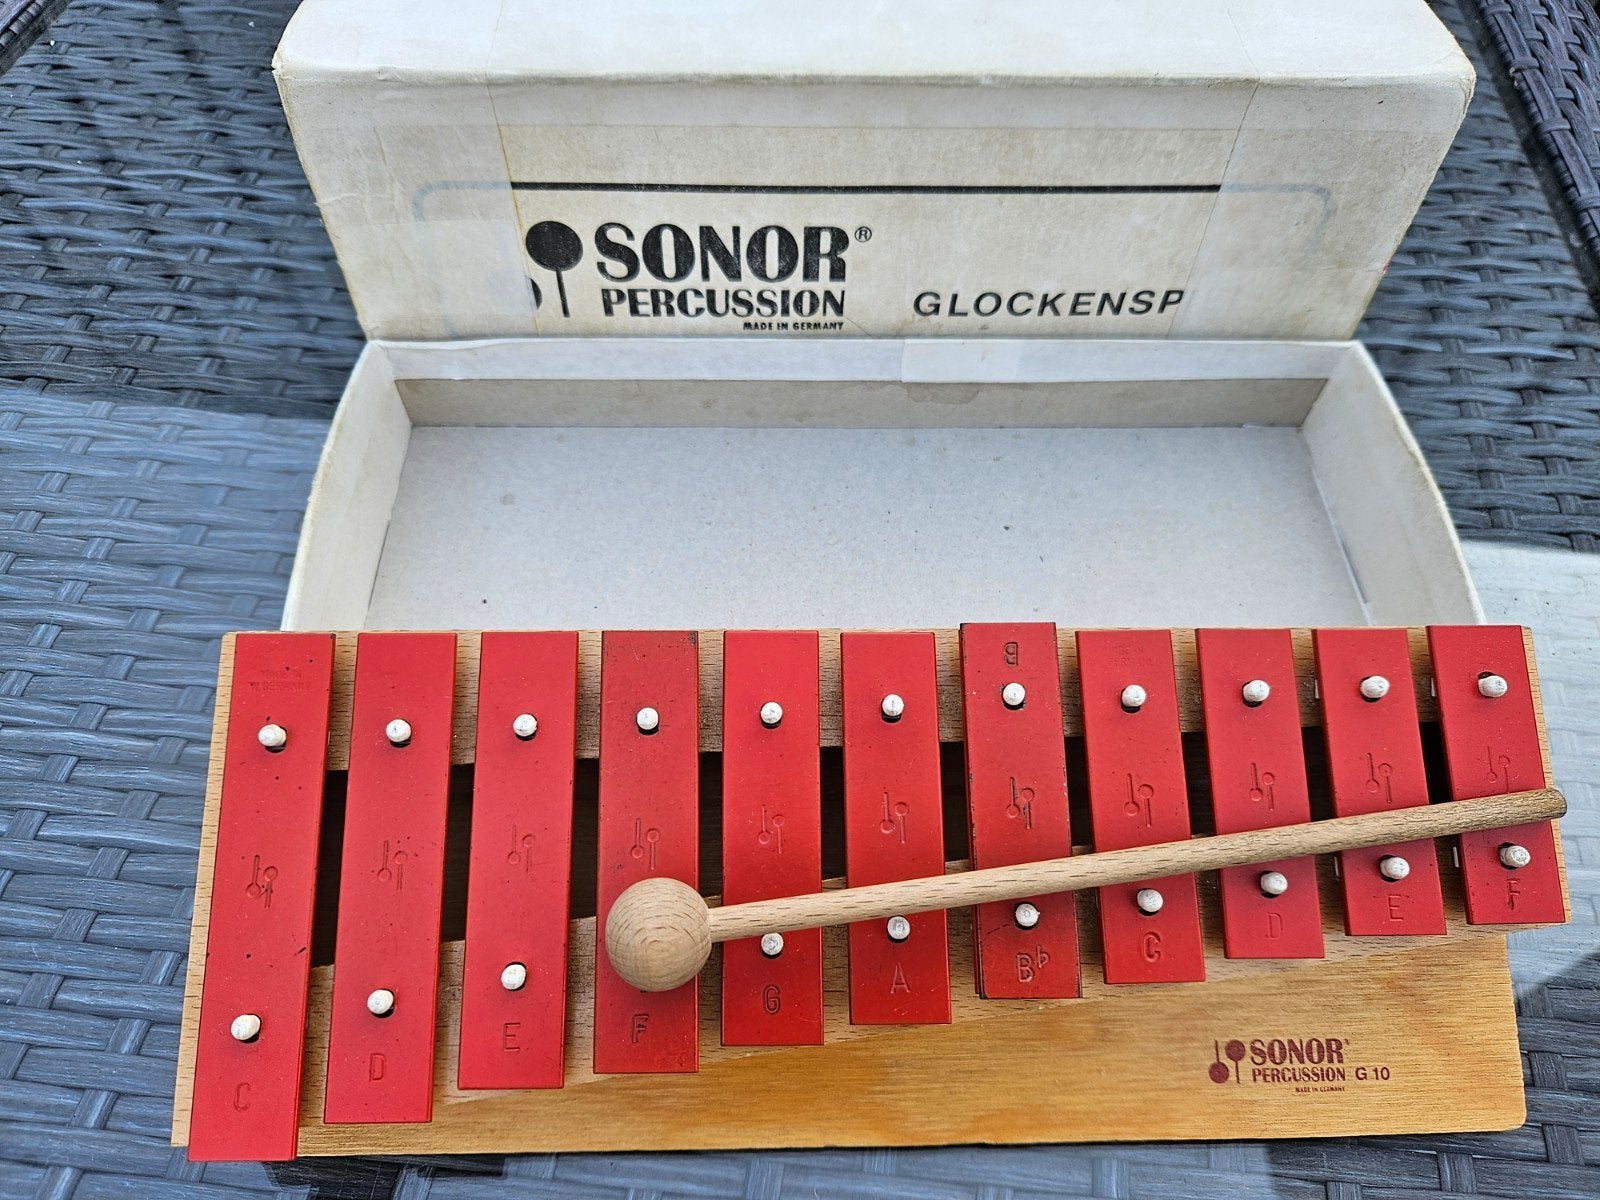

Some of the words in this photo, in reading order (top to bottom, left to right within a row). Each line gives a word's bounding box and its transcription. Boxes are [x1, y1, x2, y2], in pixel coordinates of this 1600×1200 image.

[601, 288, 846, 318] PERCUSSION
[912, 290, 1185, 317] GLOCKENSP
[743, 322, 773, 331] MADE
[776, 322, 789, 331] IN
[792, 322, 844, 331] GERMANY
[1387, 894, 1404, 922] E
[1506, 878, 1521, 910] F
[1266, 912, 1283, 940] D
[890, 964, 911, 994] A
[763, 984, 782, 1015] G
[503, 1022, 521, 1052] E
[631, 1013, 650, 1044] F
[369, 1053, 387, 1082] D
[1252, 1067, 1346, 1082] PERCUSSION
[1355, 1067, 1368, 1081] G
[1373, 1067, 1390, 1081] 10
[233, 1082, 251, 1112] C
